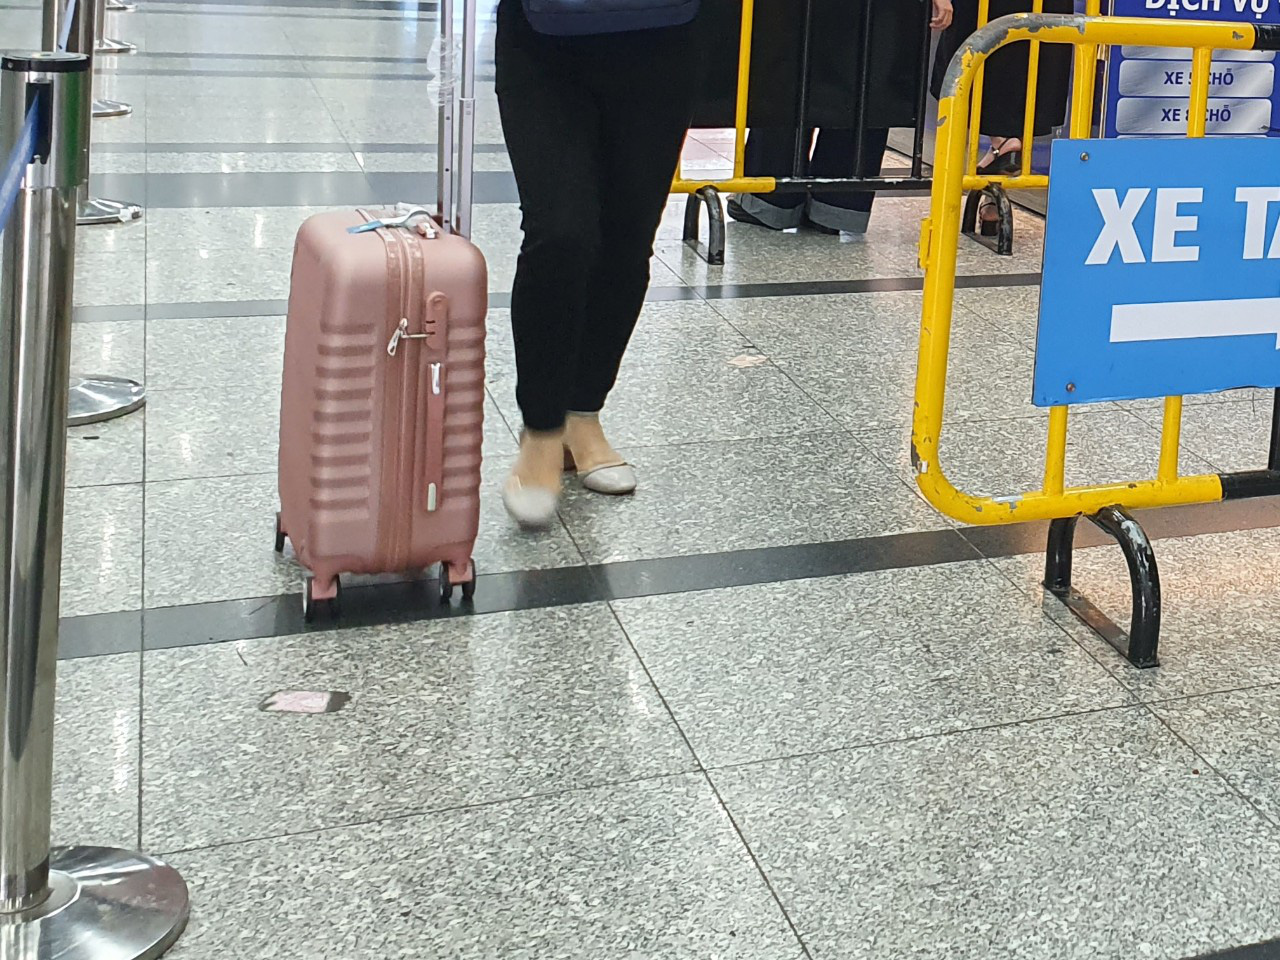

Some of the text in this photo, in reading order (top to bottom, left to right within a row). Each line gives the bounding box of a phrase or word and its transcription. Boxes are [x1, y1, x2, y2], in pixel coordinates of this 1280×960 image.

[1164, 71, 1184, 85] XE
[1160, 108, 1181, 122] XE
[1084, 187, 1204, 265] XE
